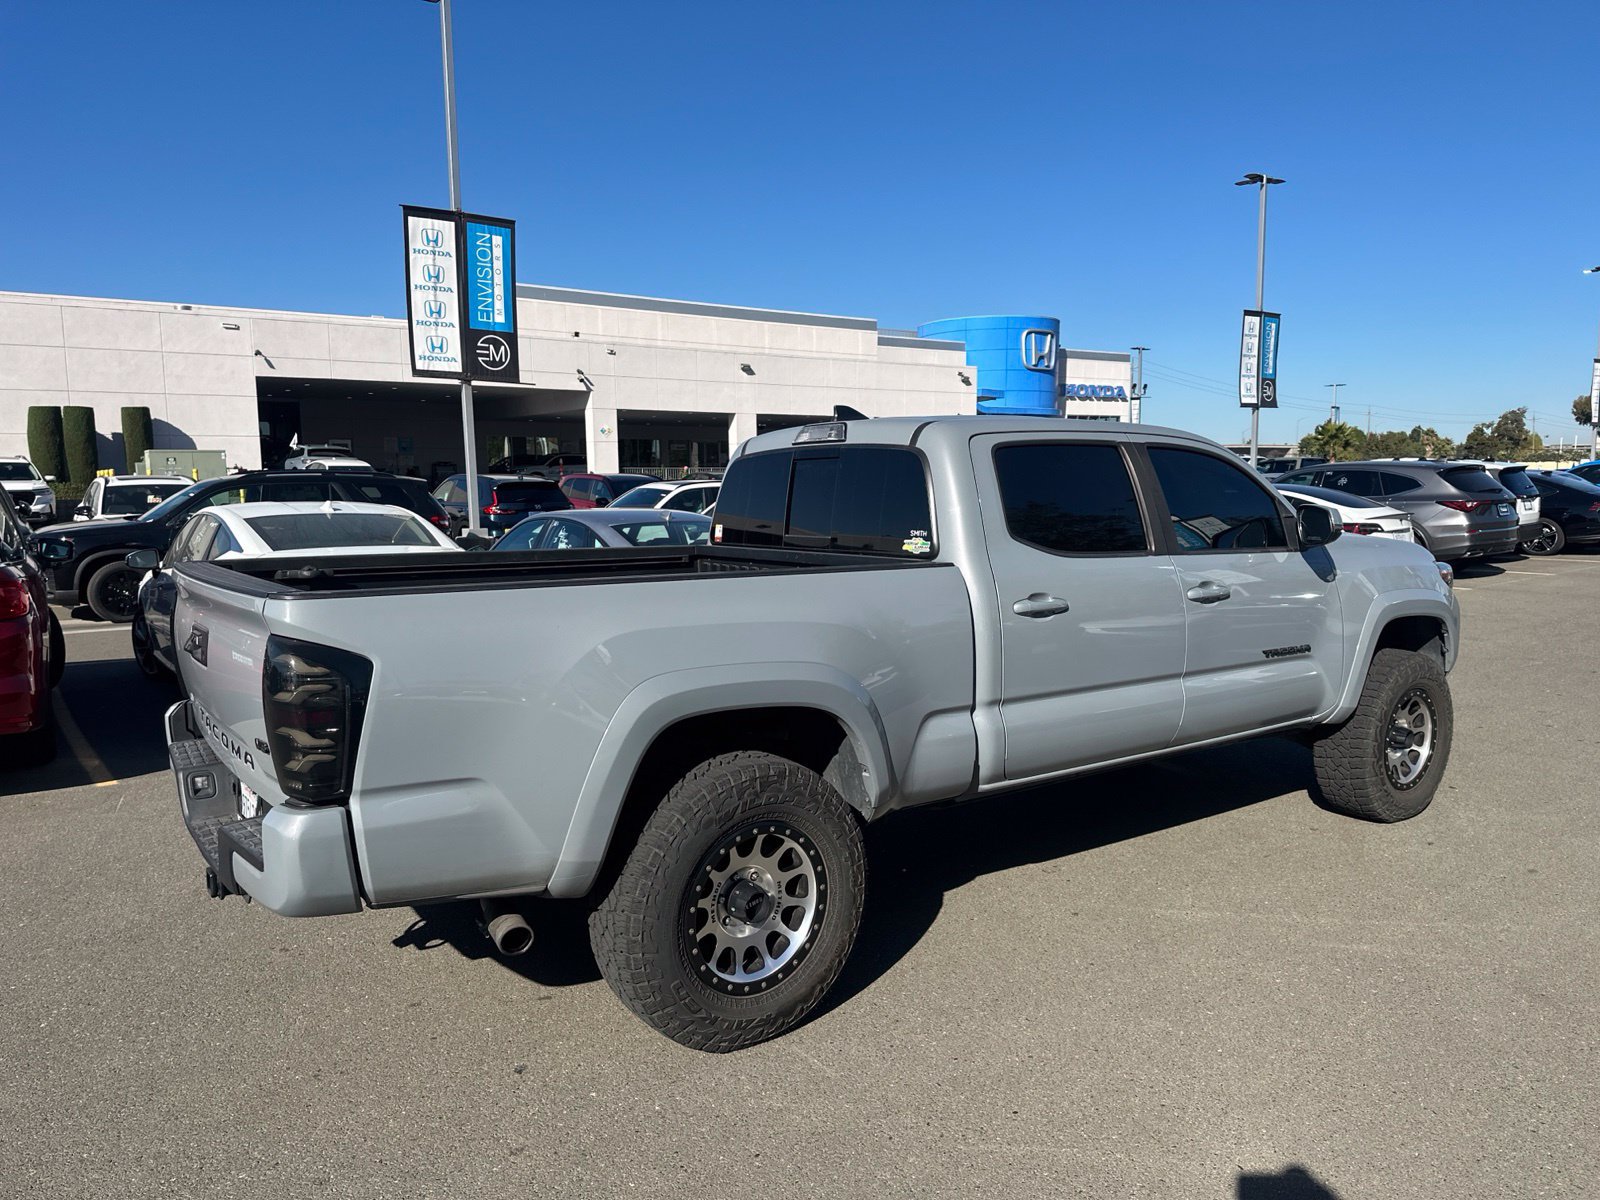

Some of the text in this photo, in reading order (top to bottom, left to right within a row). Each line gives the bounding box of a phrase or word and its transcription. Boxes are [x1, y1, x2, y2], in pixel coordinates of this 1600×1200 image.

[412, 248, 453, 258] HONDA
[414, 284, 454, 293] HONDA
[476, 232, 493, 323] ENVISION
[494, 243, 503, 316] MOTORS
[415, 319, 456, 328] HONDA
[418, 355, 458, 363] HONDA
[1066, 384, 1127, 399] HONDA
[200, 707, 256, 771] TACOMA
[710, 882, 722, 924] METHOD
[772, 880, 783, 921] METHOD
